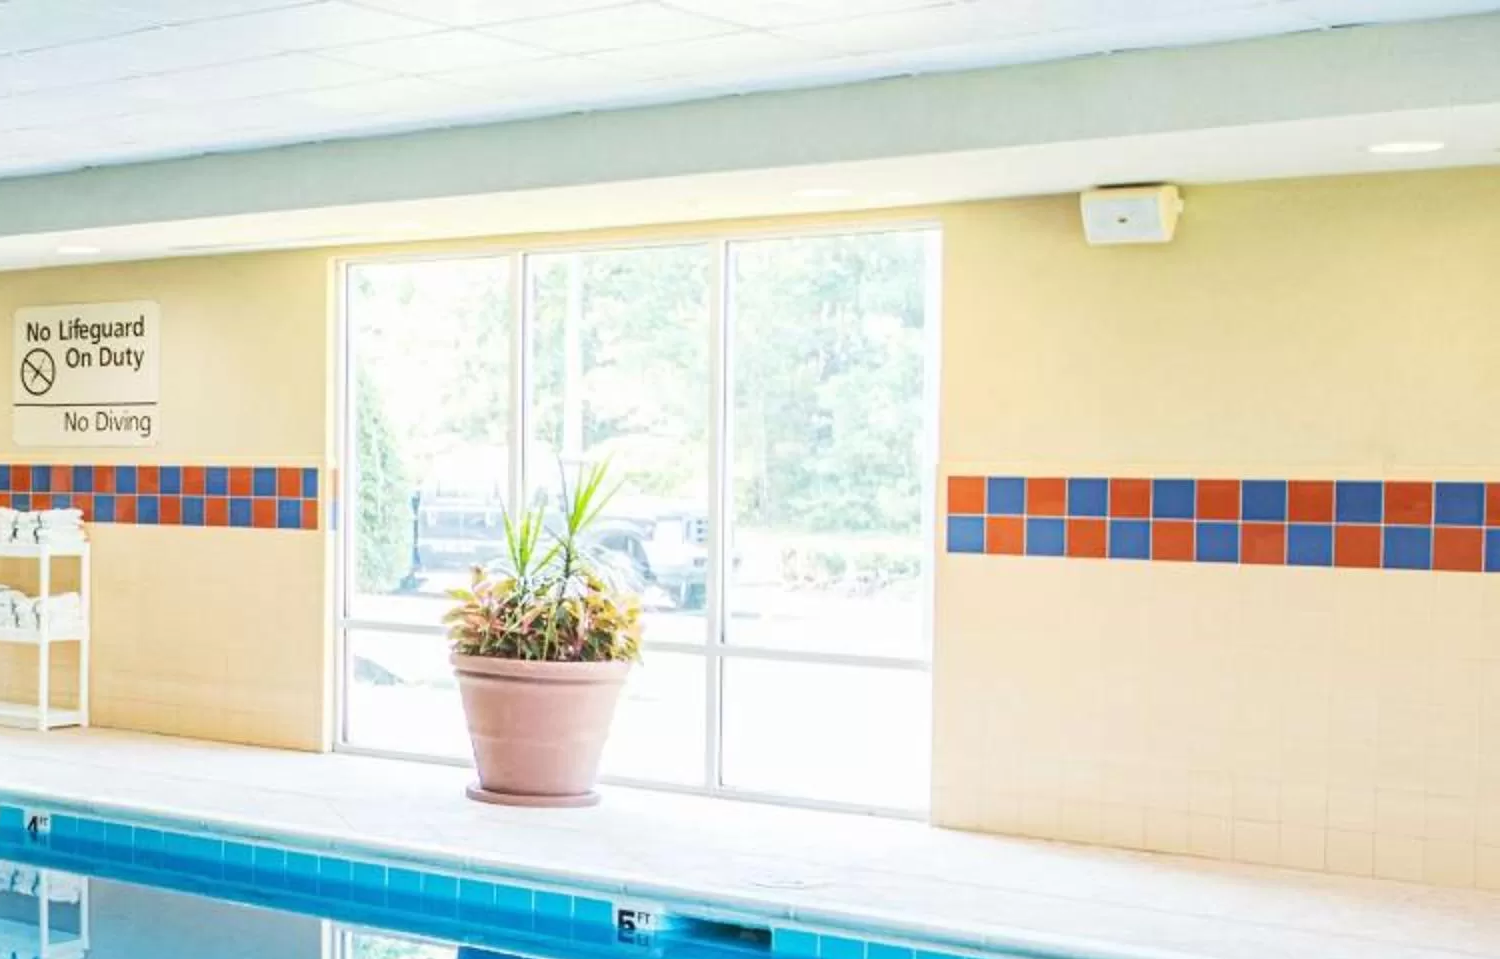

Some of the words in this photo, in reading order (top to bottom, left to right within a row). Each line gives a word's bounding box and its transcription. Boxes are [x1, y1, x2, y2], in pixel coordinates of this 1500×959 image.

[26, 321, 51, 343] No
[59, 315, 145, 345] Lifeguard
[65, 347, 92, 369] On
[100, 347, 145, 372] Duty
[64, 411, 89, 432] No
[96, 409, 152, 438] Diving
